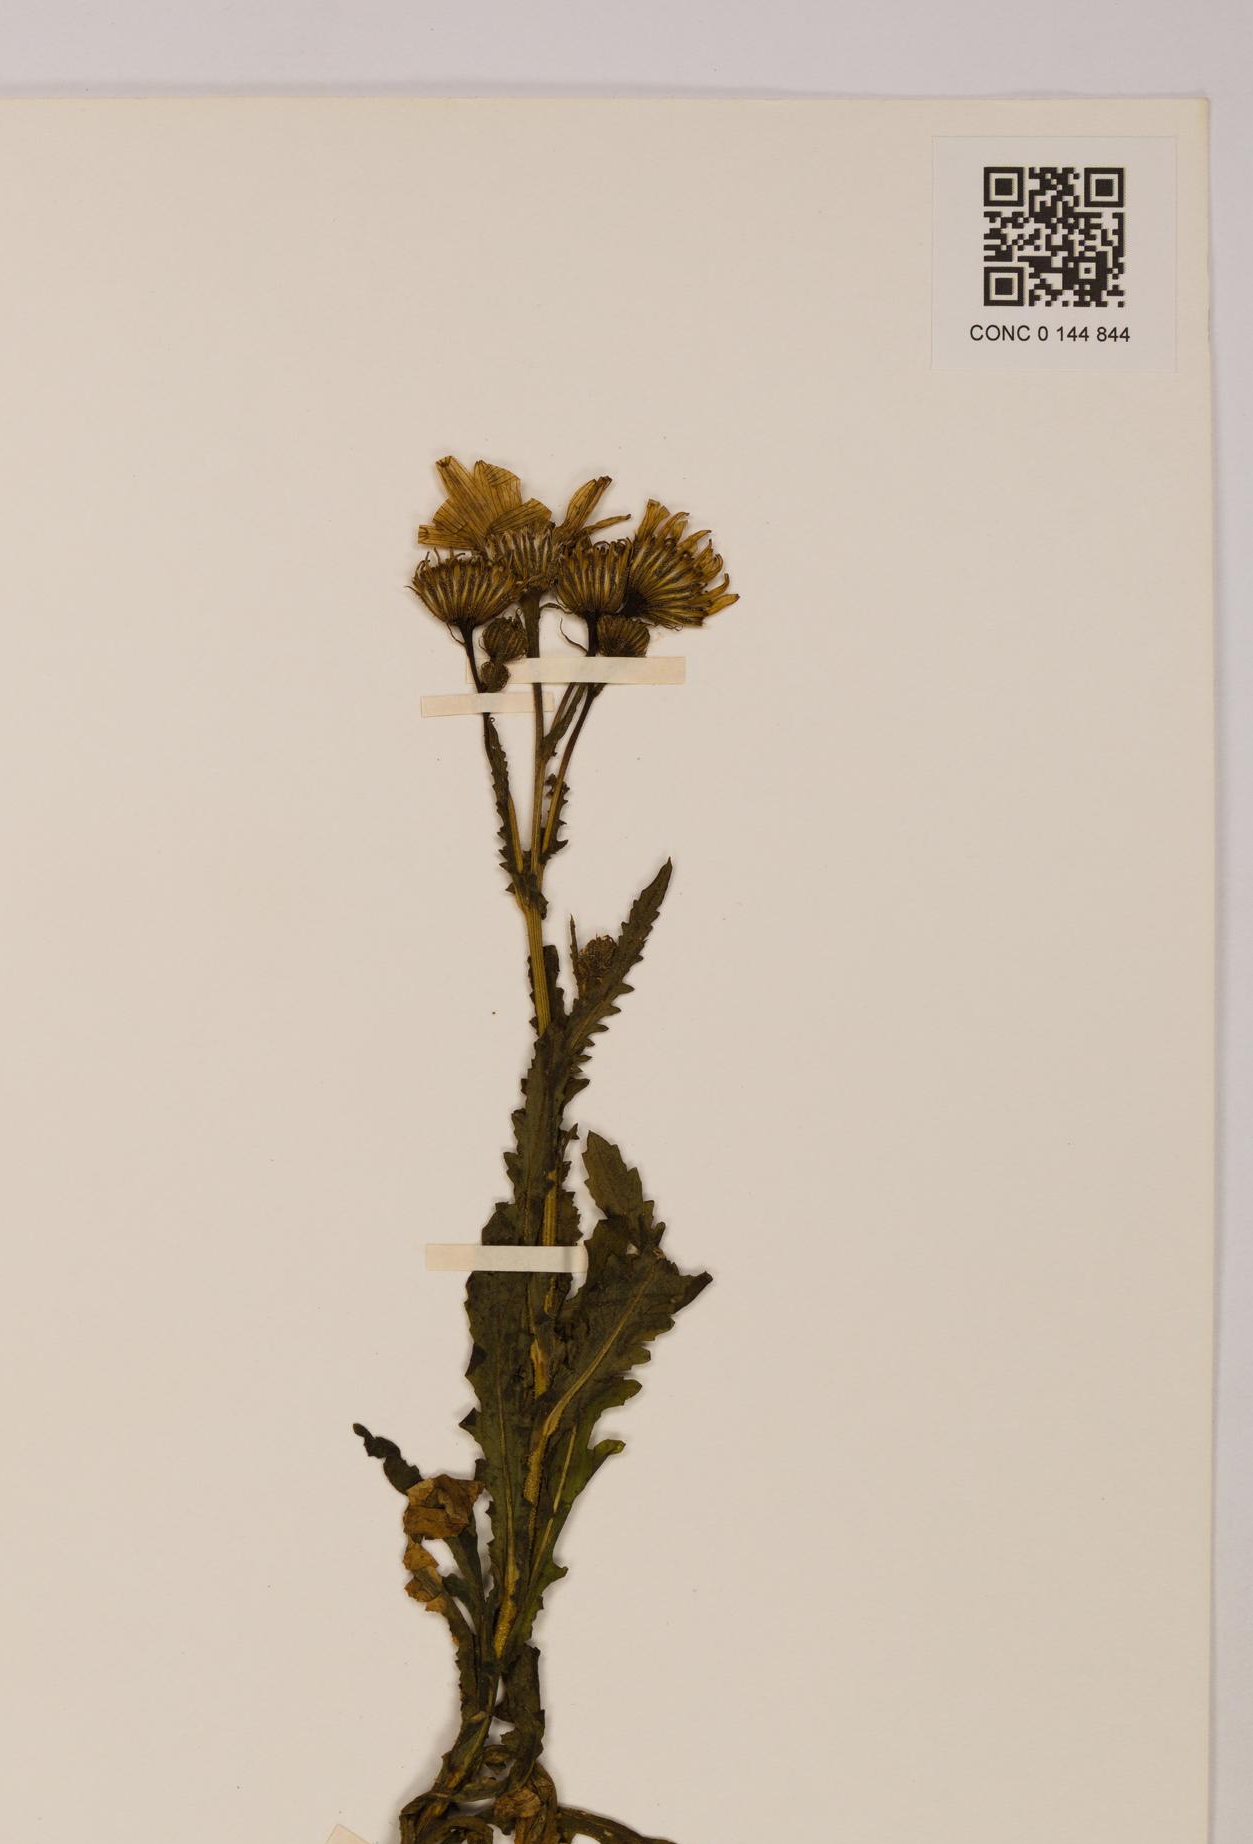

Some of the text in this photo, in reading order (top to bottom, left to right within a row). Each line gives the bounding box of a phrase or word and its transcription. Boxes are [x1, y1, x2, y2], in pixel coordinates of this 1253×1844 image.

[969, 324, 1131, 343] CONC 0 144 844
